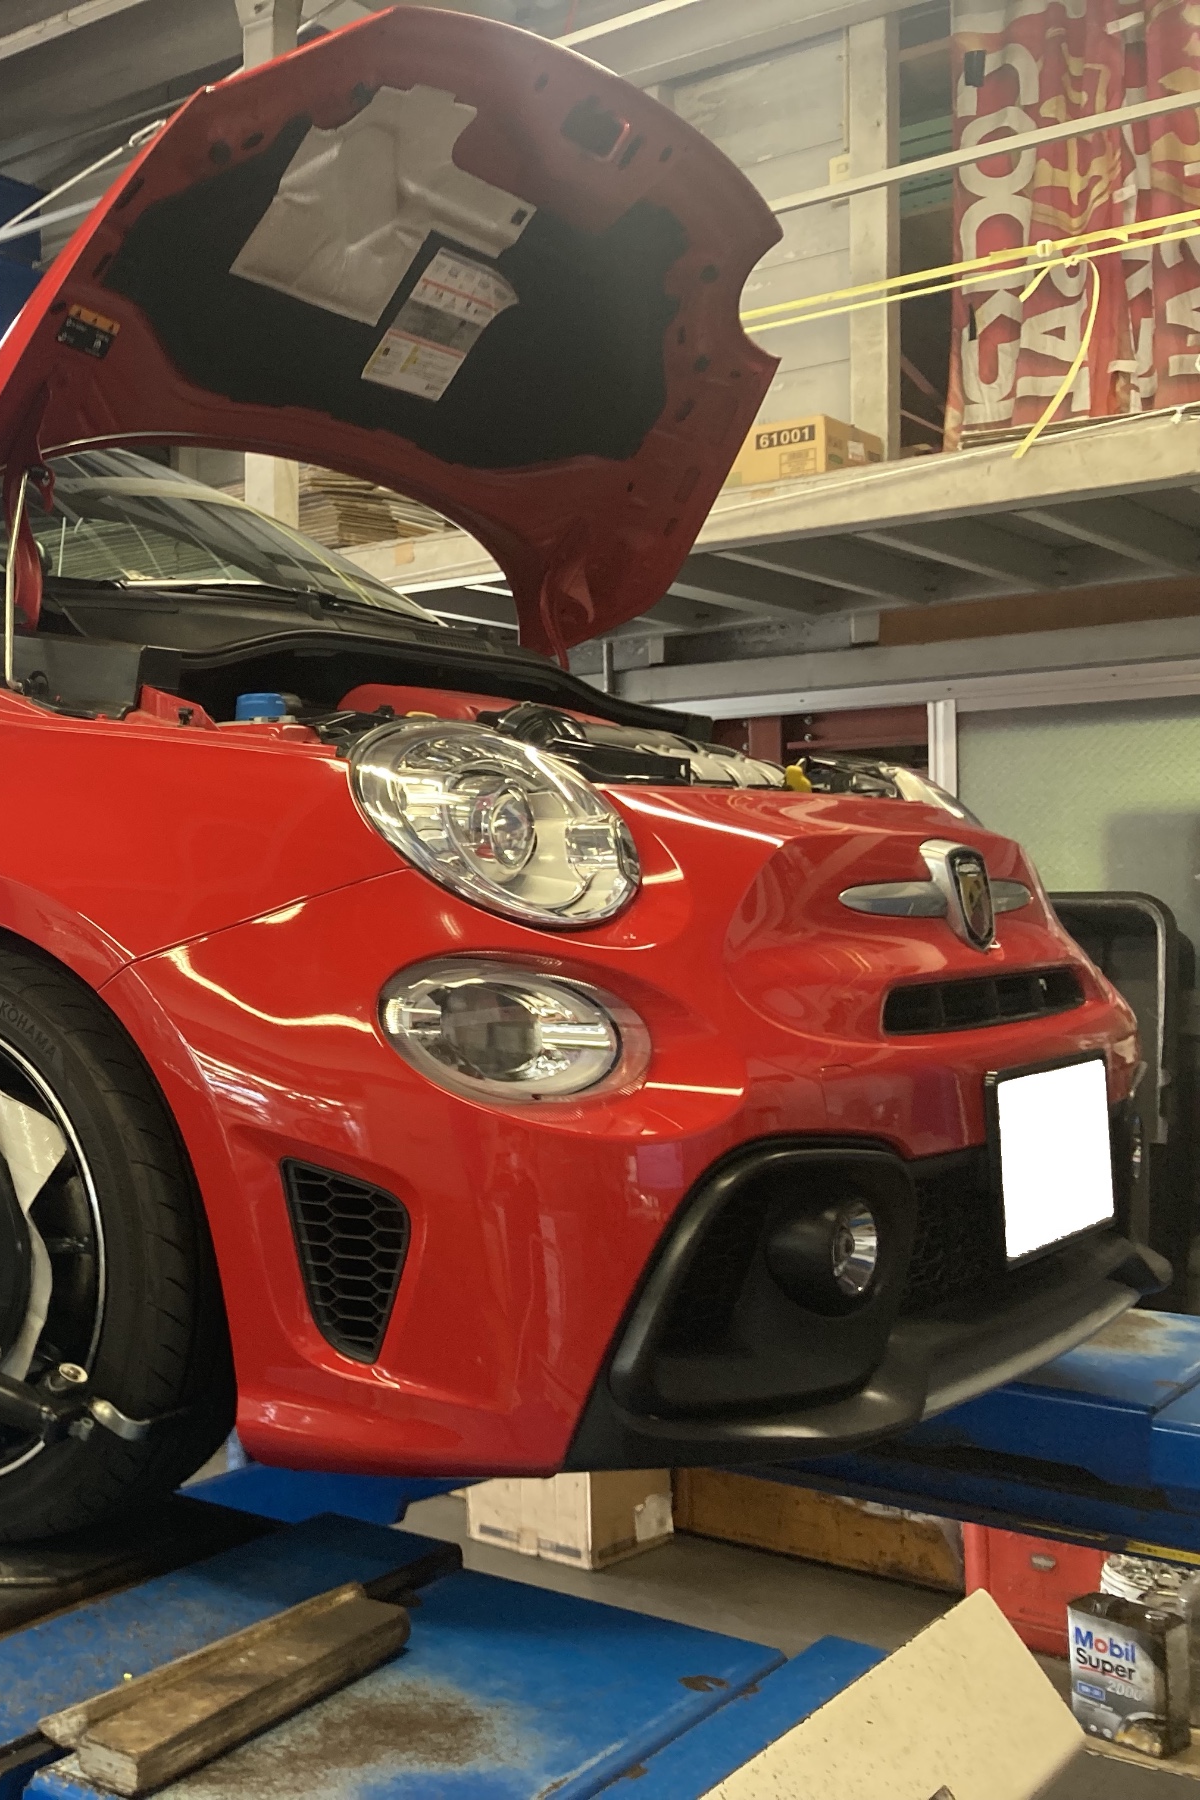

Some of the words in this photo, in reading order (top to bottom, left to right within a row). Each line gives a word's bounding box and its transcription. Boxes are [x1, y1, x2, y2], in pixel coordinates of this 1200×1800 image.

[759, 426, 811, 449] 61001
[1074, 1626, 1137, 1665] Mobil
[1075, 1647, 1137, 1681] Super
